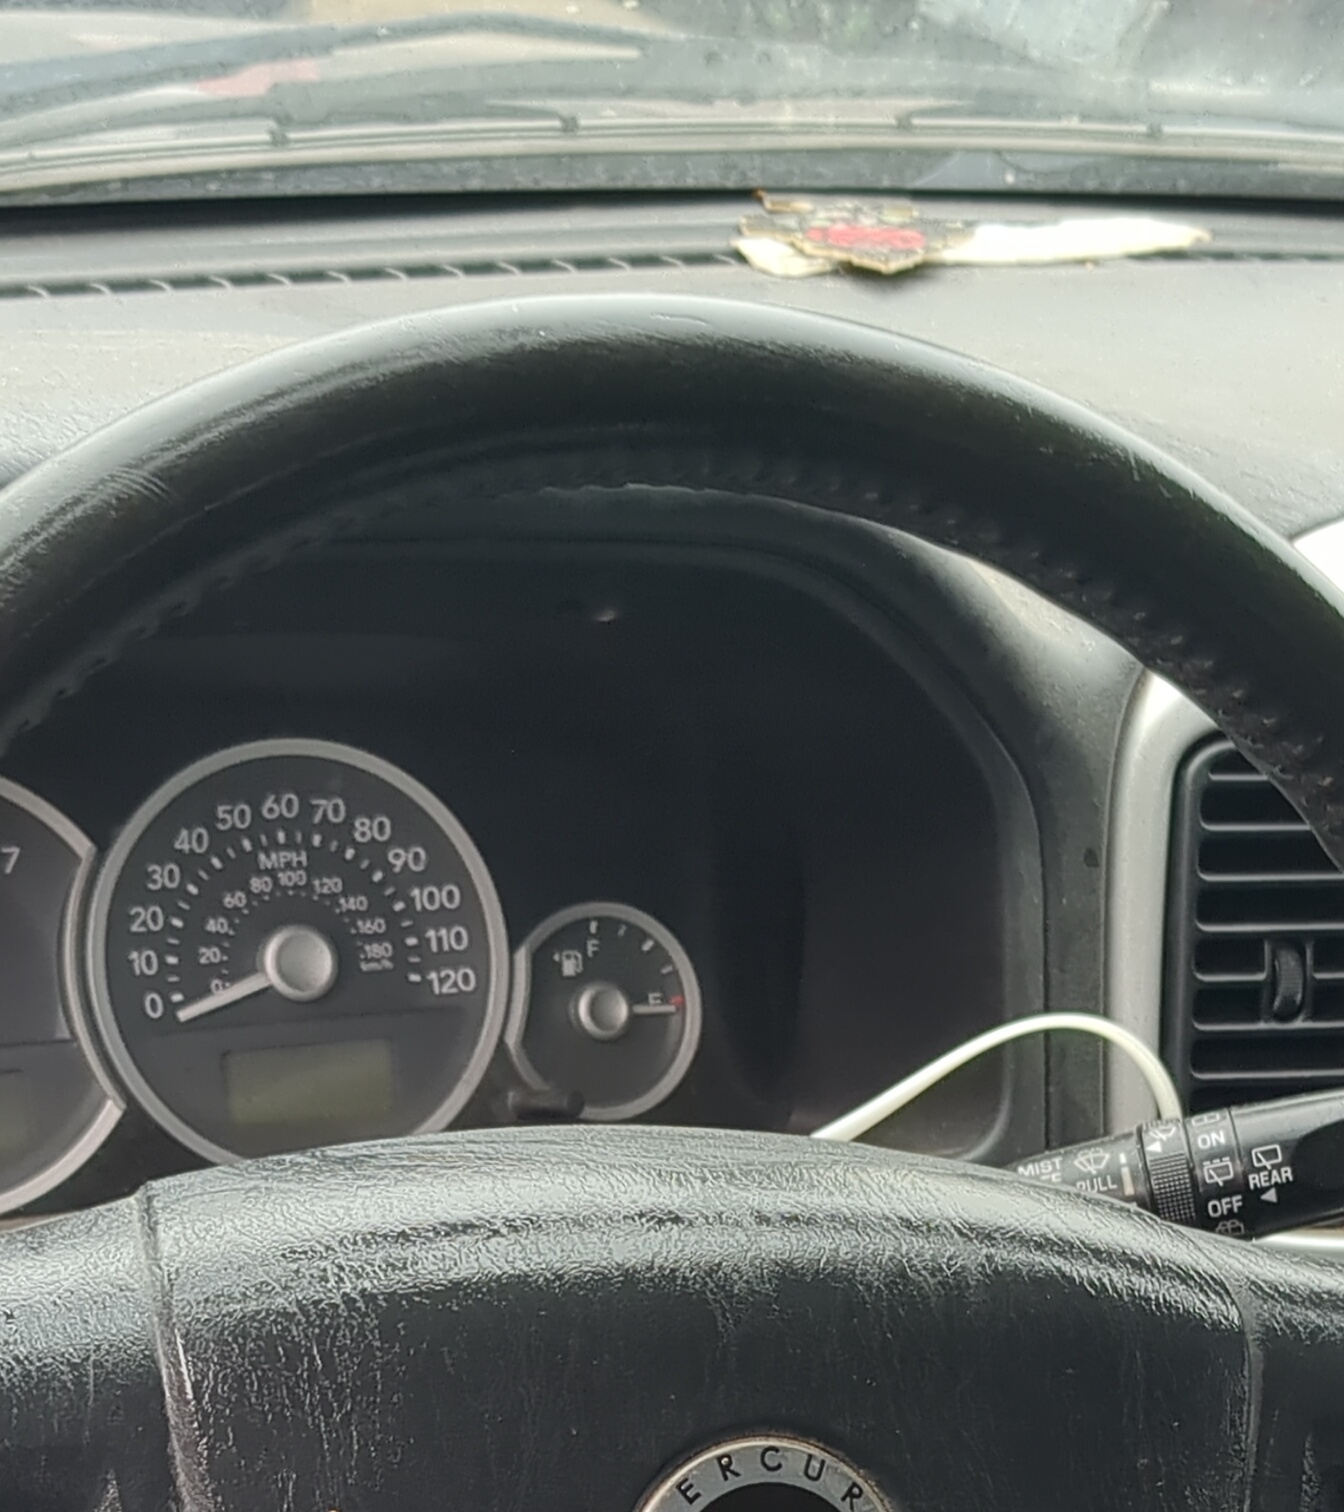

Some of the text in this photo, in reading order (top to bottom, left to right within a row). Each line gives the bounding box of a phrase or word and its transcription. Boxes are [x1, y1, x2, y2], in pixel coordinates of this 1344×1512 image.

[216, 803, 252, 831] 50
[262, 794, 299, 819] 60
[311, 799, 346, 825] 70
[174, 827, 209, 855] 40
[354, 816, 392, 843] 80
[0, 846, 21, 874] 7
[258, 851, 307, 870] MPH
[387, 847, 427, 873] 90
[146, 864, 181, 891] 30
[249, 876, 273, 893] 80
[278, 871, 306, 886] 100
[313, 877, 343, 894] 120
[223, 891, 247, 908] 60
[338, 896, 368, 911] 140
[410, 884, 461, 911] 100
[129, 906, 164, 933] 20
[205, 917, 228, 934] 40
[356, 918, 386, 934] 160
[364, 942, 393, 960] 180
[425, 926, 469, 952] 110
[586, 939, 601, 957] F
[128, 950, 159, 977] 10
[199, 947, 221, 965] 20
[426, 968, 477, 995] 120
[144, 993, 163, 1019] 0
[1197, 1130, 1225, 1150] ON
[1017, 1156, 1063, 1177] MIST
[1248, 1167, 1293, 1190] REAR
[1207, 1194, 1243, 1218] OFF
